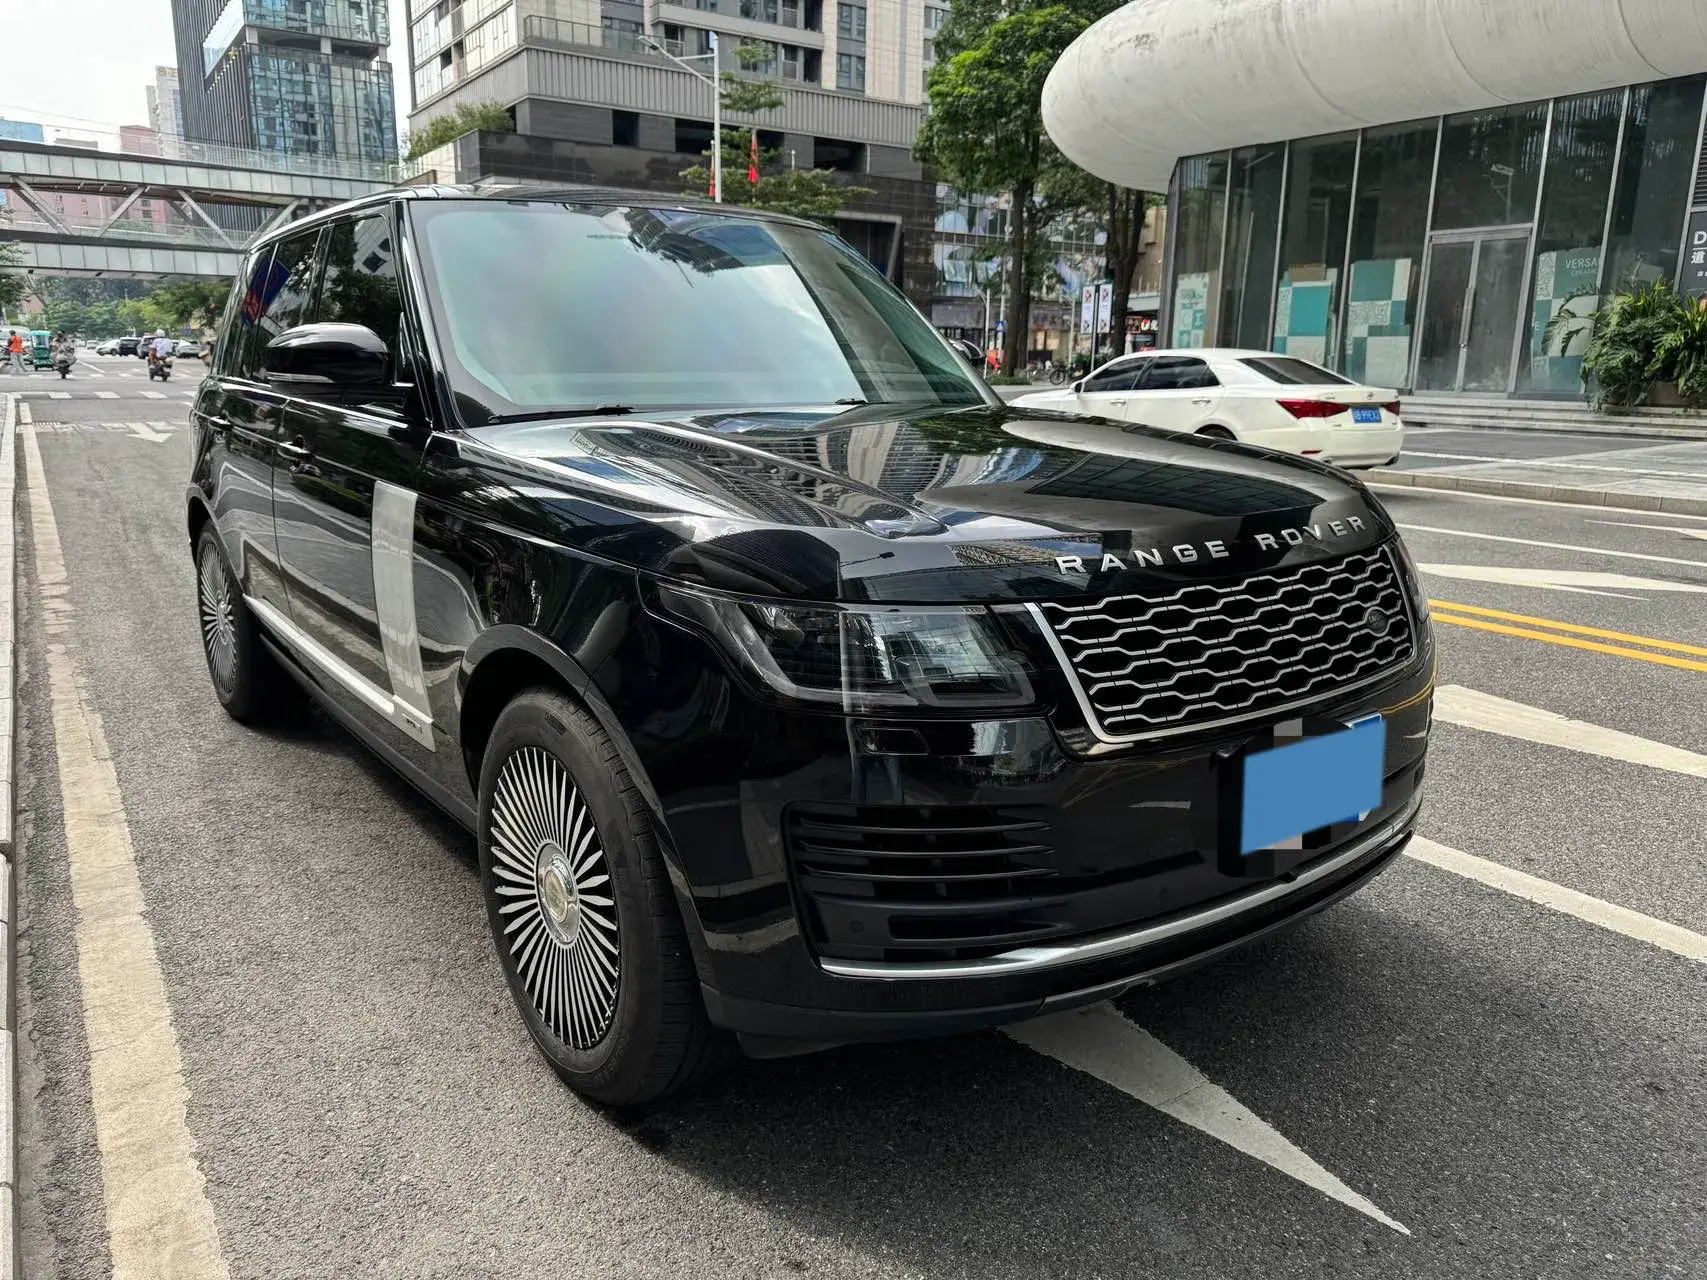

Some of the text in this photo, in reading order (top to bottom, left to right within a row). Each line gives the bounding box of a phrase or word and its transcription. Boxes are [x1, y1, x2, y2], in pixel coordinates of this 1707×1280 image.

[1565, 256, 1600, 270] VERSA
[1055, 515, 1367, 575] RANGE ROVER
